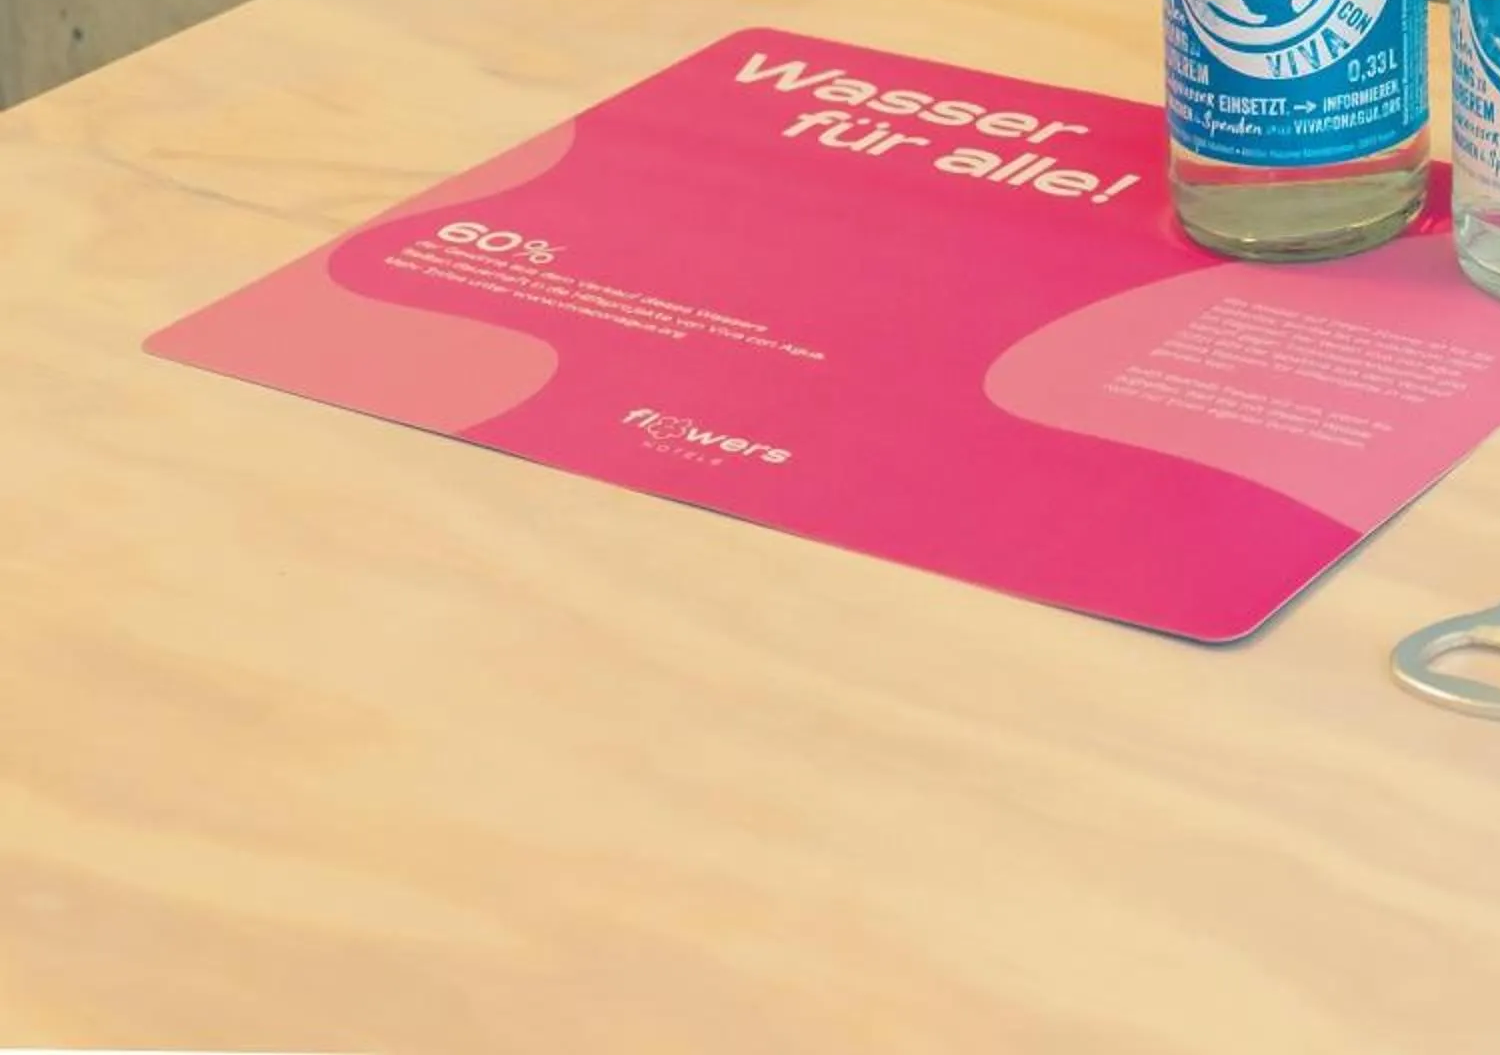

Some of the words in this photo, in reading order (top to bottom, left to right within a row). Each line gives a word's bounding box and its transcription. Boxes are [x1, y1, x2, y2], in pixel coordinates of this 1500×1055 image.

[1265, 26, 1351, 78] VIVA
[1336, 0, 1374, 35] CON
[734, 51, 1091, 145] Wasser
[1200, 109, 1263, 139] Spenden
[782, 108, 932, 157] für
[932, 146, 1143, 205] alle!
[436, 221, 568, 265] 60%
[621, 407, 793, 465] flowers
